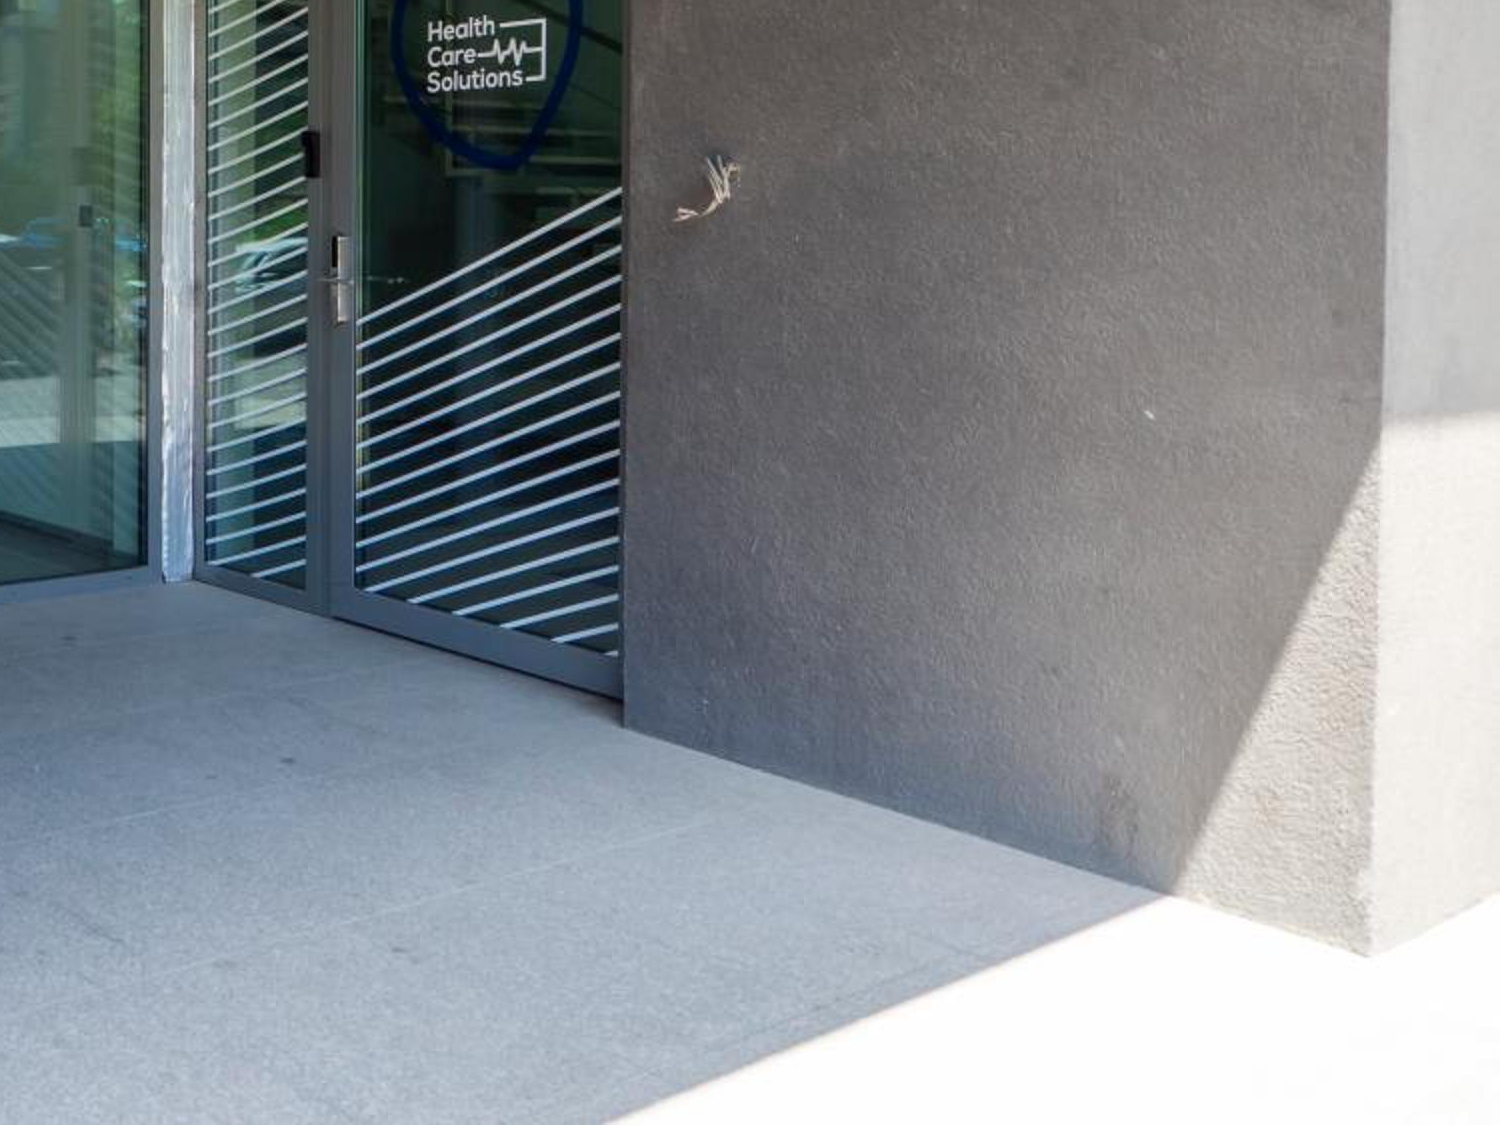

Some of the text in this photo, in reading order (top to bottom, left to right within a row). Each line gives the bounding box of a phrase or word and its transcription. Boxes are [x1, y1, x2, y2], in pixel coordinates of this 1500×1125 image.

[427, 15, 495, 42] Health
[427, 46, 477, 67] Care
[427, 68, 523, 93] Solutions
